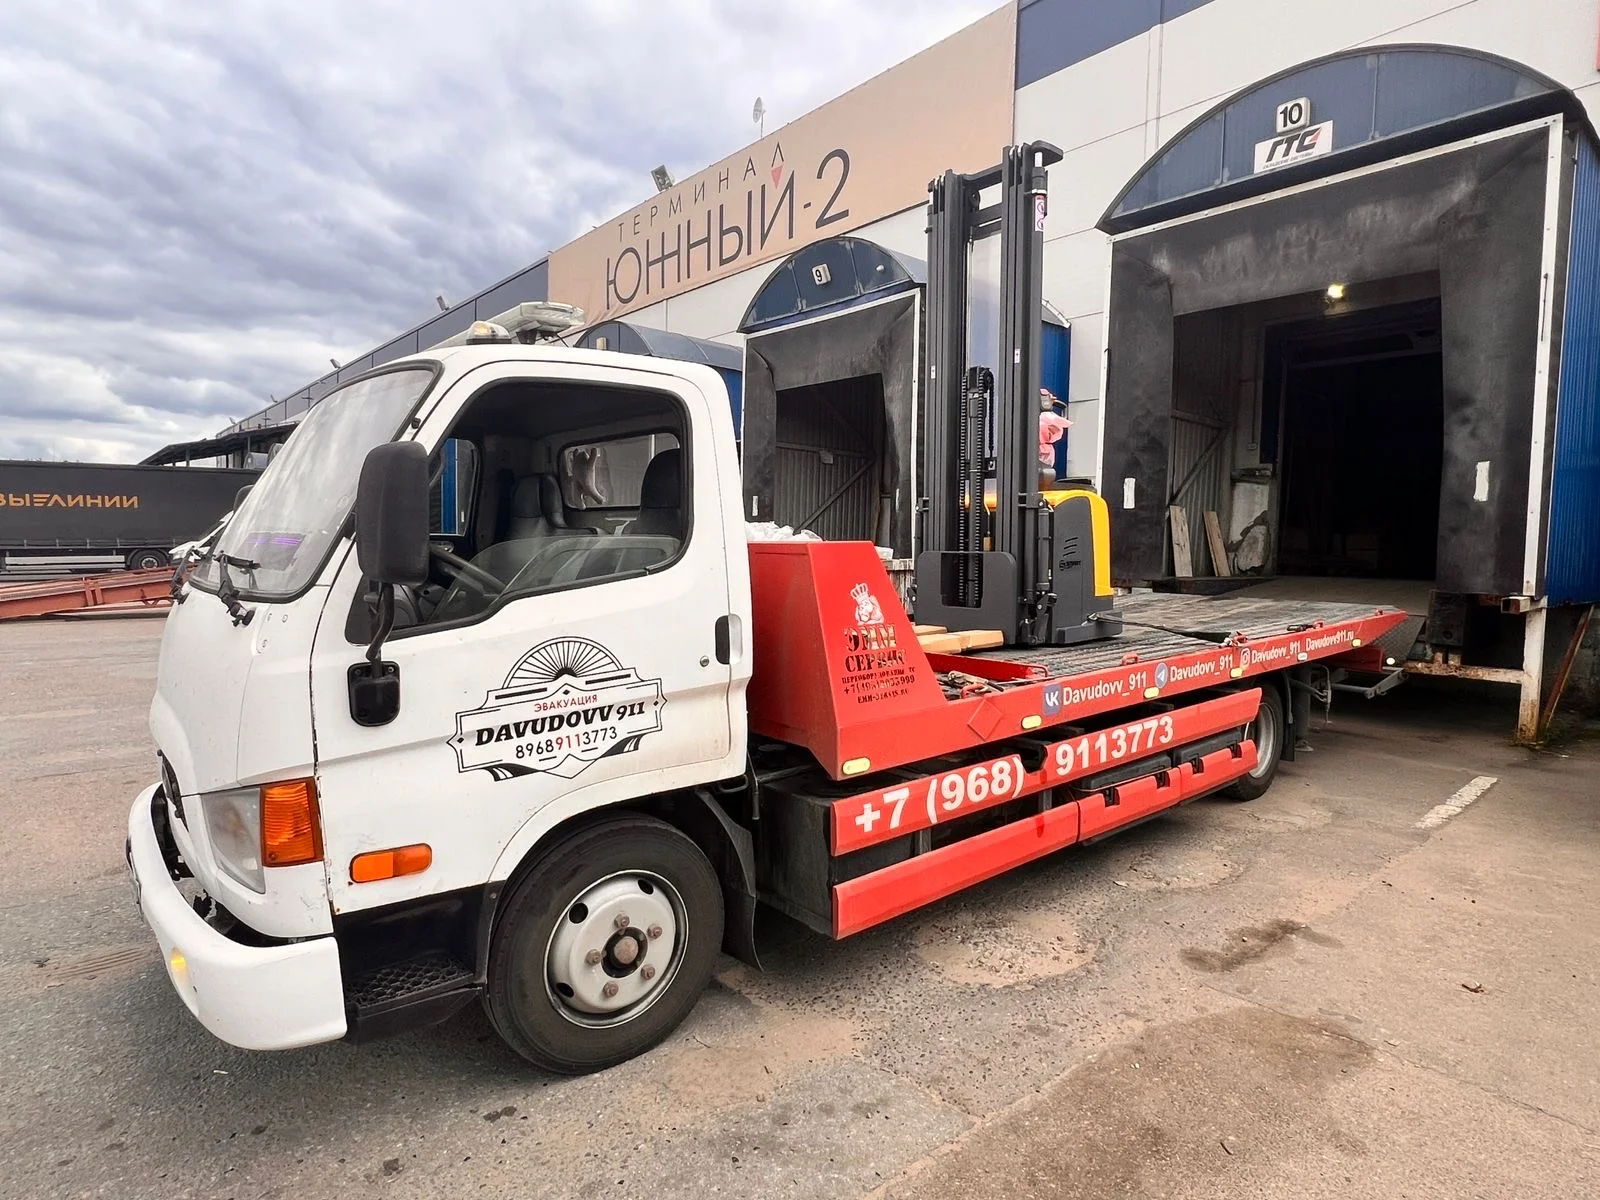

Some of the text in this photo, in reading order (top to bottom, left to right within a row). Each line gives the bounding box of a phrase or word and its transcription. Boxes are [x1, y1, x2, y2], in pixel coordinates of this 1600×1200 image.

[1280, 102, 1303, 128] 10
[1266, 127, 1322, 163] ГТС
[618, 141, 785, 242] ТЕРМИНАЛ
[815, 269, 823, 282] 9
[1063, 671, 1147, 706] Davudovv_911
[1170, 654, 1233, 683] Davudovv_911
[1251, 641, 1301, 664] Davudovv_911
[533, 694, 598, 713] ЭВАКУАЦИЯ
[475, 701, 646, 746] DAVUDOVV 911
[515, 726, 618, 760] 89689113773
[855, 715, 1175, 833] +7 (968) 9113773
